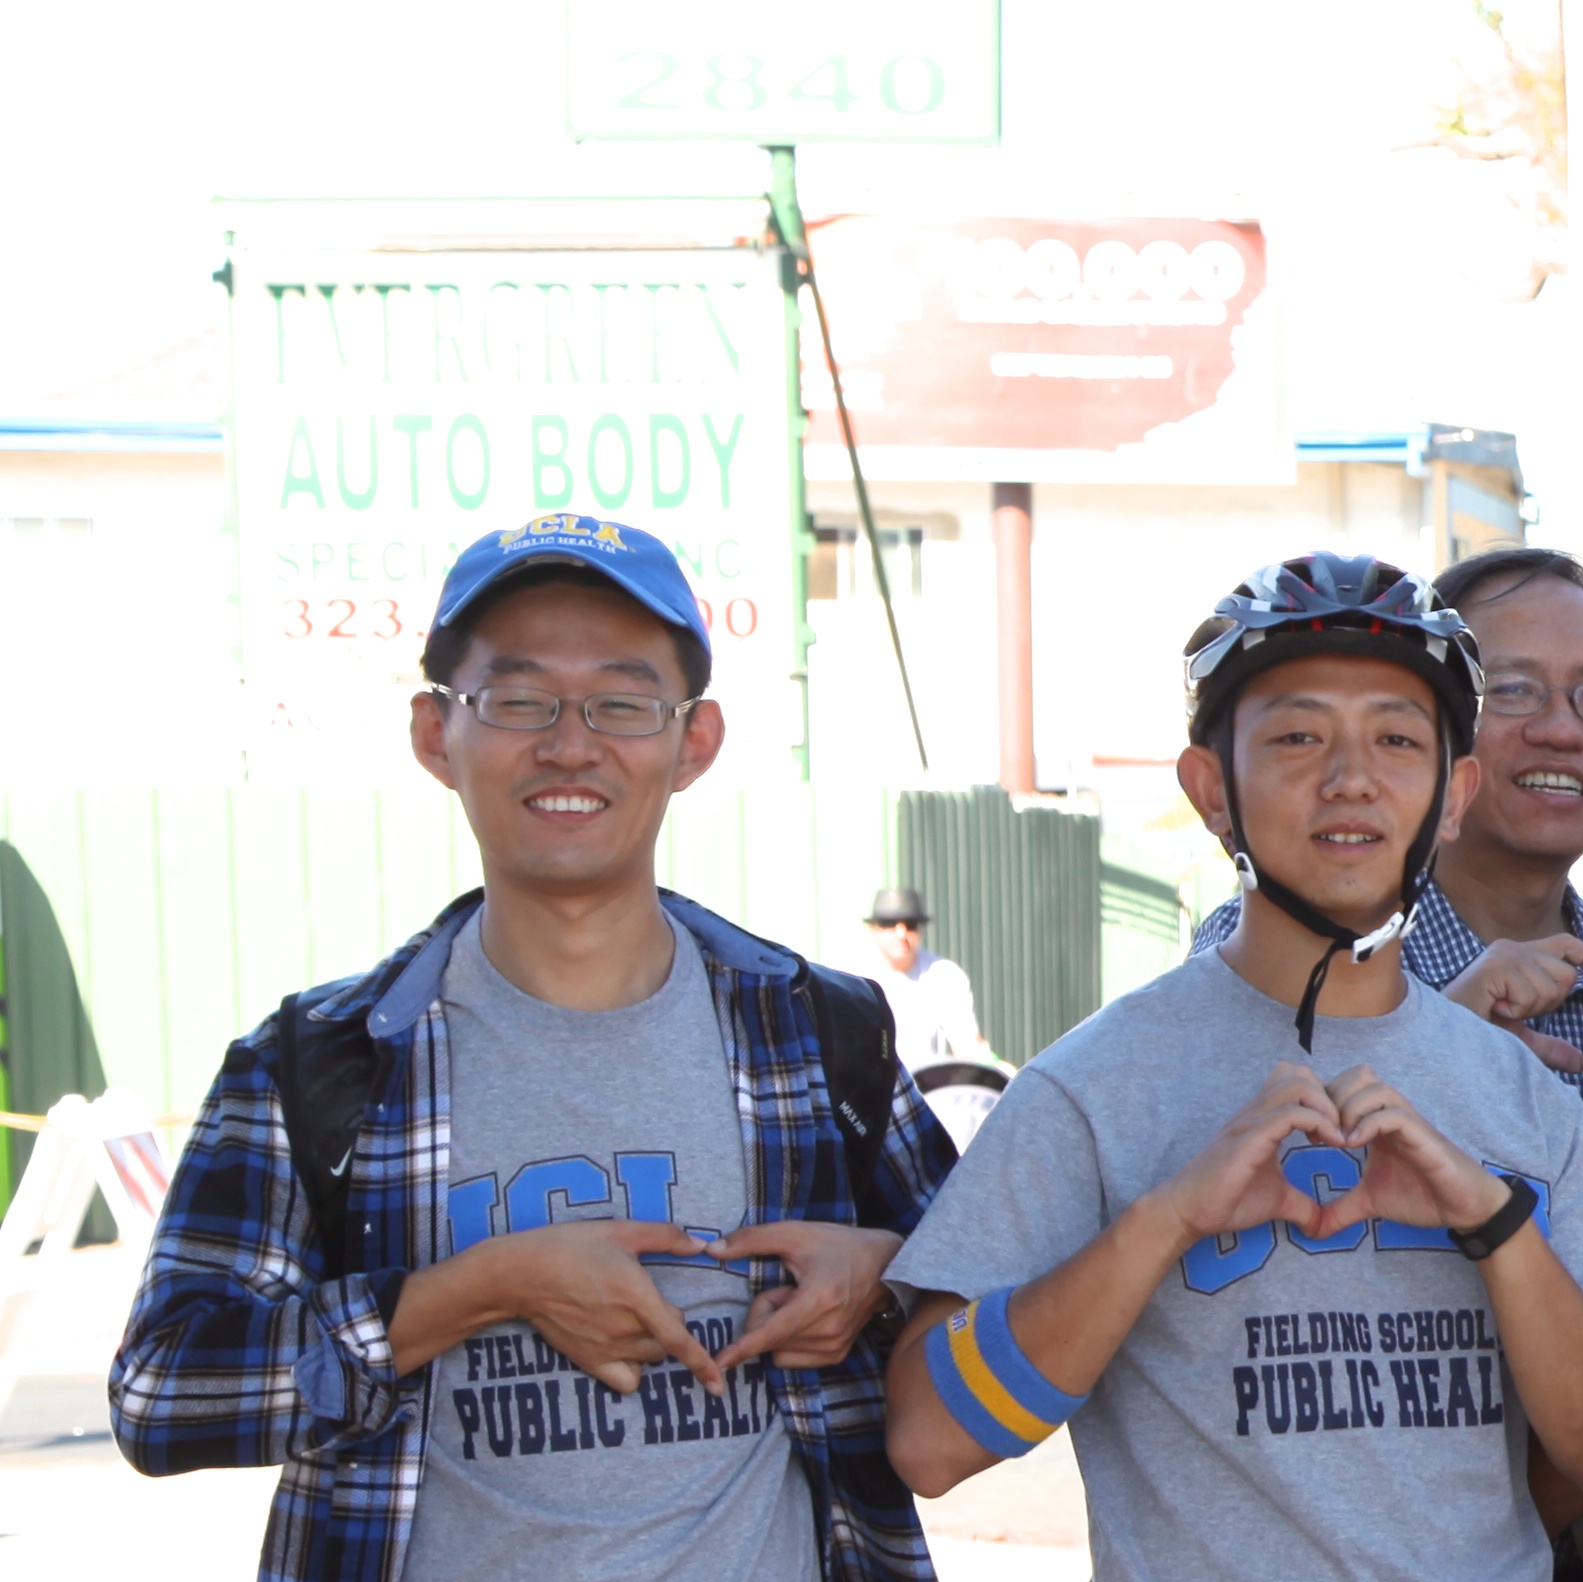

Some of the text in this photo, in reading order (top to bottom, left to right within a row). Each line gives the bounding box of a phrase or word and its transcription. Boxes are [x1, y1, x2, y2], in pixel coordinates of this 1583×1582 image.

[615, 48, 948, 116] 2840
[264, 281, 748, 385] EVERGREEN
[279, 412, 745, 512] AUTO BODY
[499, 515, 628, 552] UCLA
[502, 536, 617, 554] PUBLIC HEALTH
[1244, 1309, 1496, 1359] FIELDING SCHOOL
[452, 1363, 779, 1460] PUBLIC HEALT
[1232, 1359, 1385, 1437] PUBLIC
